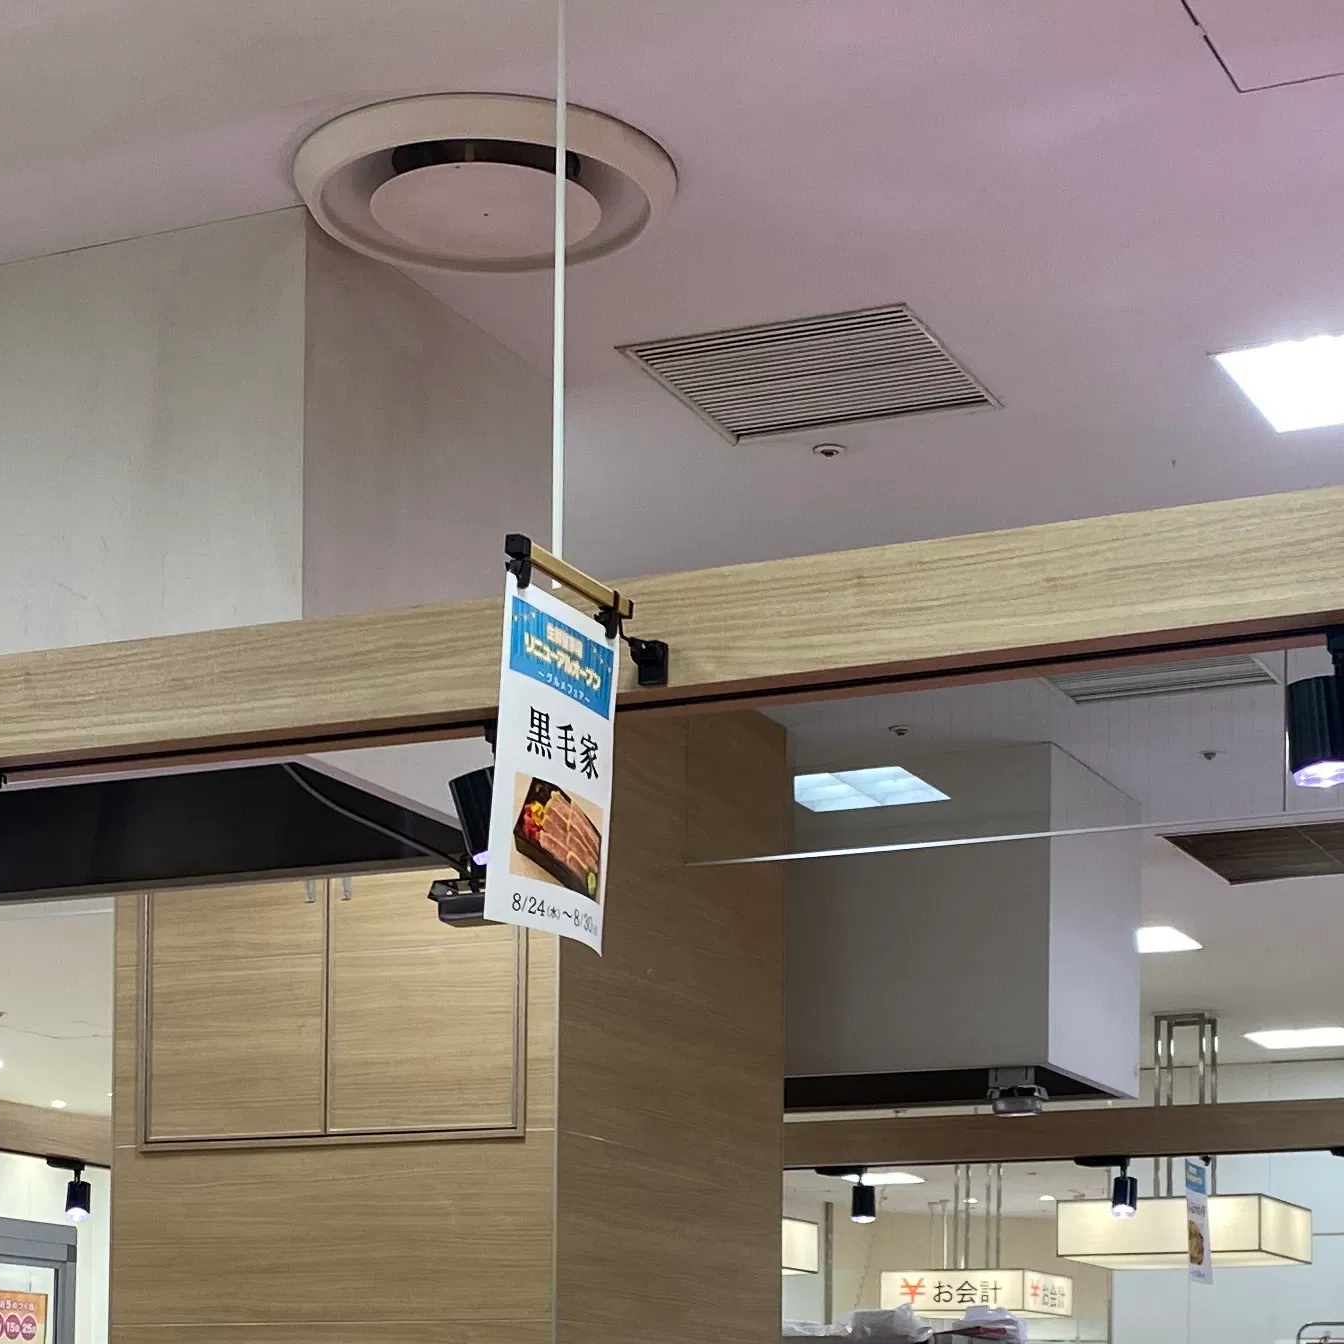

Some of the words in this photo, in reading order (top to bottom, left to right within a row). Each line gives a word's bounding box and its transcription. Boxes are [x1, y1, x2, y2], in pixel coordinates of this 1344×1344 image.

[526, 706, 599, 780] 黒毛家
[933, 1280, 1002, 1304] お会計
